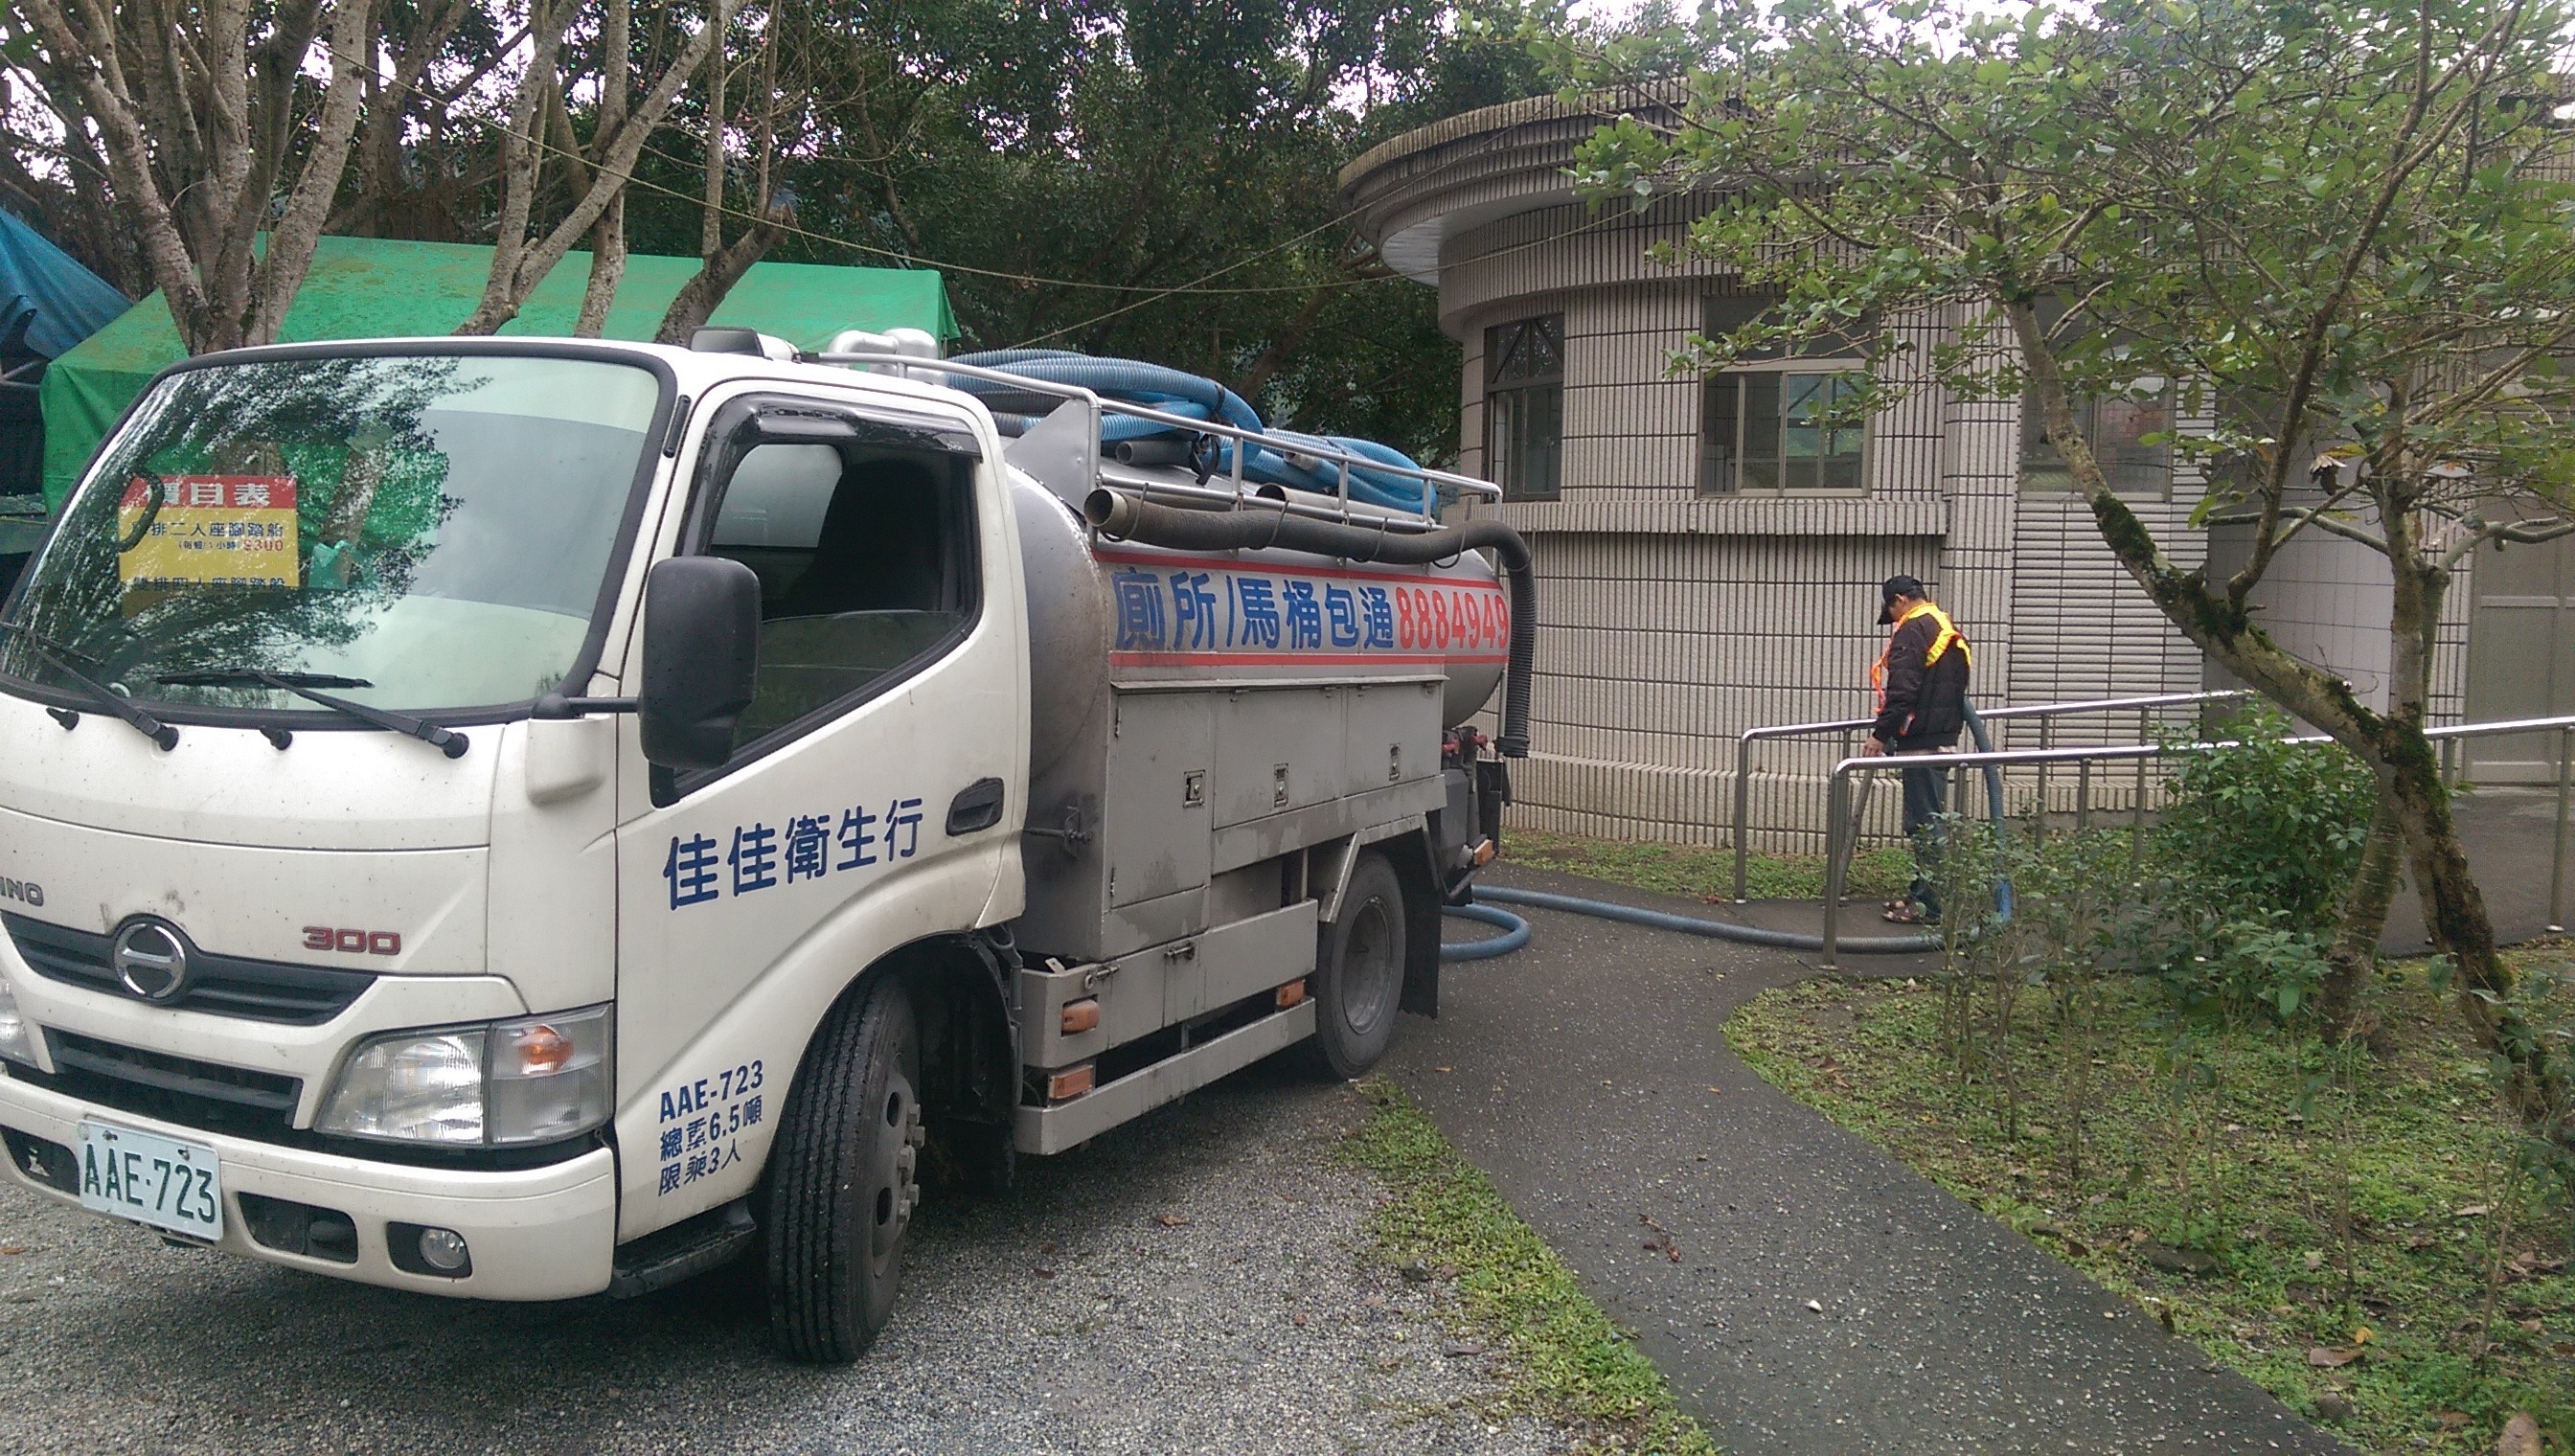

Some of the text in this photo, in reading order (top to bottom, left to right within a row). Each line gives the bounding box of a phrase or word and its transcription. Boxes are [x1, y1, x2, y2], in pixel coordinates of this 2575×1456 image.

[132, 522, 285, 537] 排二人座腳踏船
[243, 539, 284, 552] $300
[1396, 586, 1509, 649] 8884949
[663, 798, 923, 911] 佳佳衛生行
[303, 926, 401, 956] 300
[660, 1059, 763, 1125] AAE-723
[84, 1143, 216, 1224] AAE-723
[658, 1138, 741, 1197] 限乘3人
